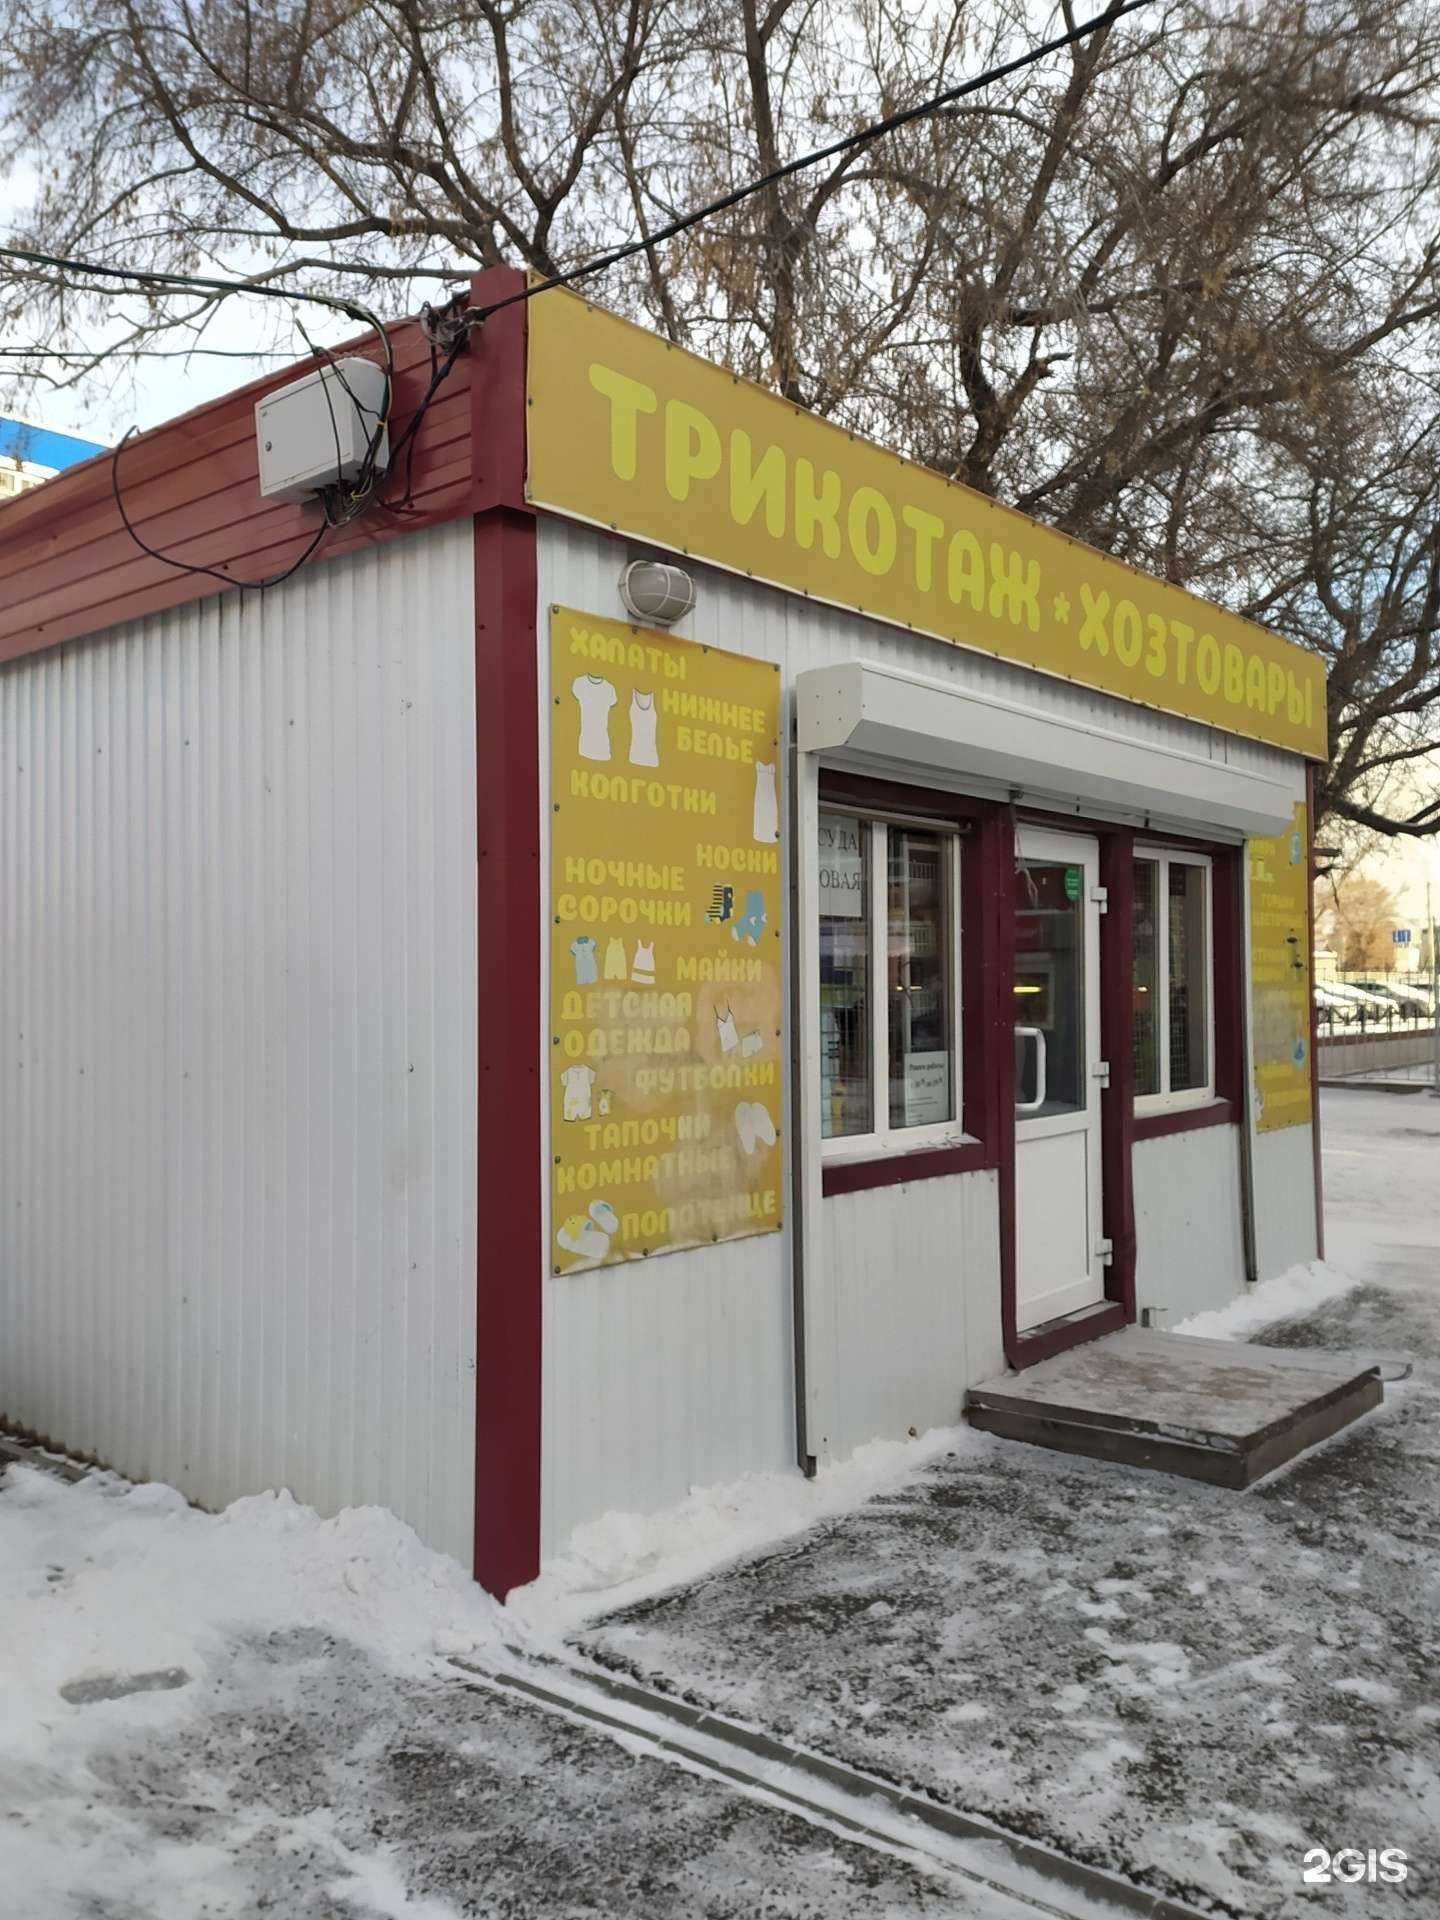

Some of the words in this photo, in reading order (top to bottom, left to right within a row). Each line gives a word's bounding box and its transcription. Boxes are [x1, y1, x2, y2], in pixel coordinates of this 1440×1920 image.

[589, 363, 1040, 632] ТРИКОТАЖ
[1079, 582, 1313, 729] ХОЗТОВАРЫ
[569, 627, 687, 680] ХАЛАТЫ
[662, 688, 766, 733] НИЖНЕЕ
[676, 726, 753, 764] БЕЛЬЕ
[570, 769, 717, 815] КОЛГОТКИ
[564, 856, 686, 891] НОЧНЫЕ
[695, 843, 777, 874] НОСКИ
[557, 894, 691, 926] СОРОЧКИ
[676, 949, 763, 982] МАЙКИ
[561, 990, 693, 1020] ДЕТСКАЯ
[563, 1027, 691, 1057] ОДЕЖДА
[635, 1061, 775, 1094] ФУТБОЛКИ
[584, 1114, 712, 1151] ТАПОЧКИ
